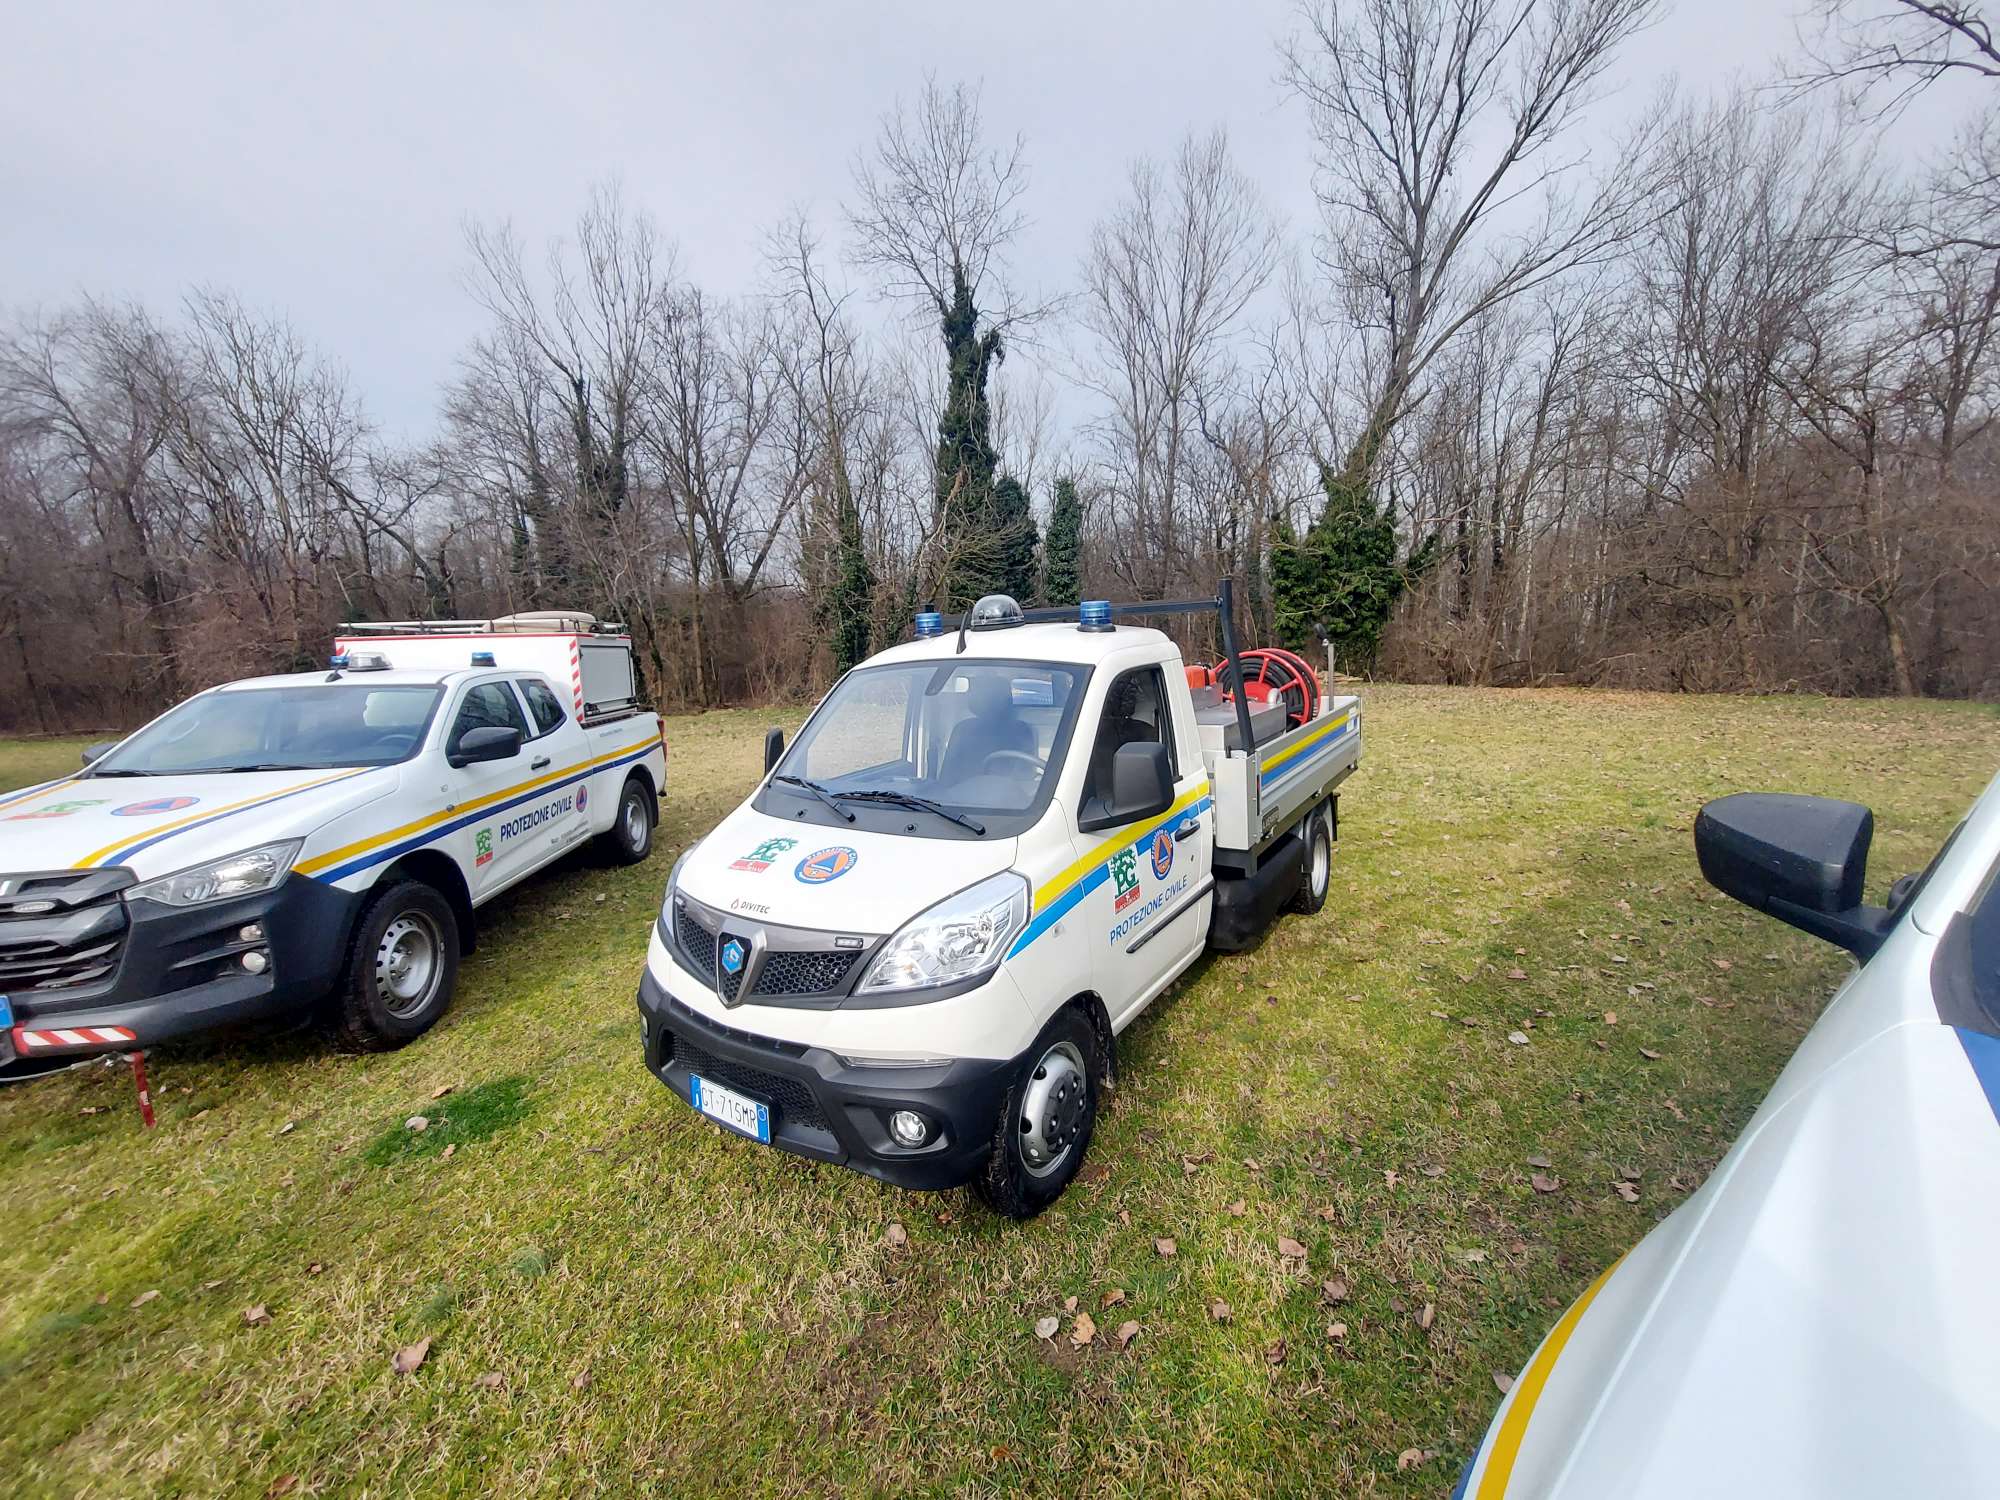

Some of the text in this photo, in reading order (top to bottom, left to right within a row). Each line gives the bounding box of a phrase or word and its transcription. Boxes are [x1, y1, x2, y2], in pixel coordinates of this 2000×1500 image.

[500, 806, 549, 842] PROTEZIONE
[551, 795, 572, 818] CIVILE
[740, 901, 770, 914] DIVITEC
[1109, 893, 1163, 947] PROTEZIONE
[1165, 874, 1188, 904] CIVILE
